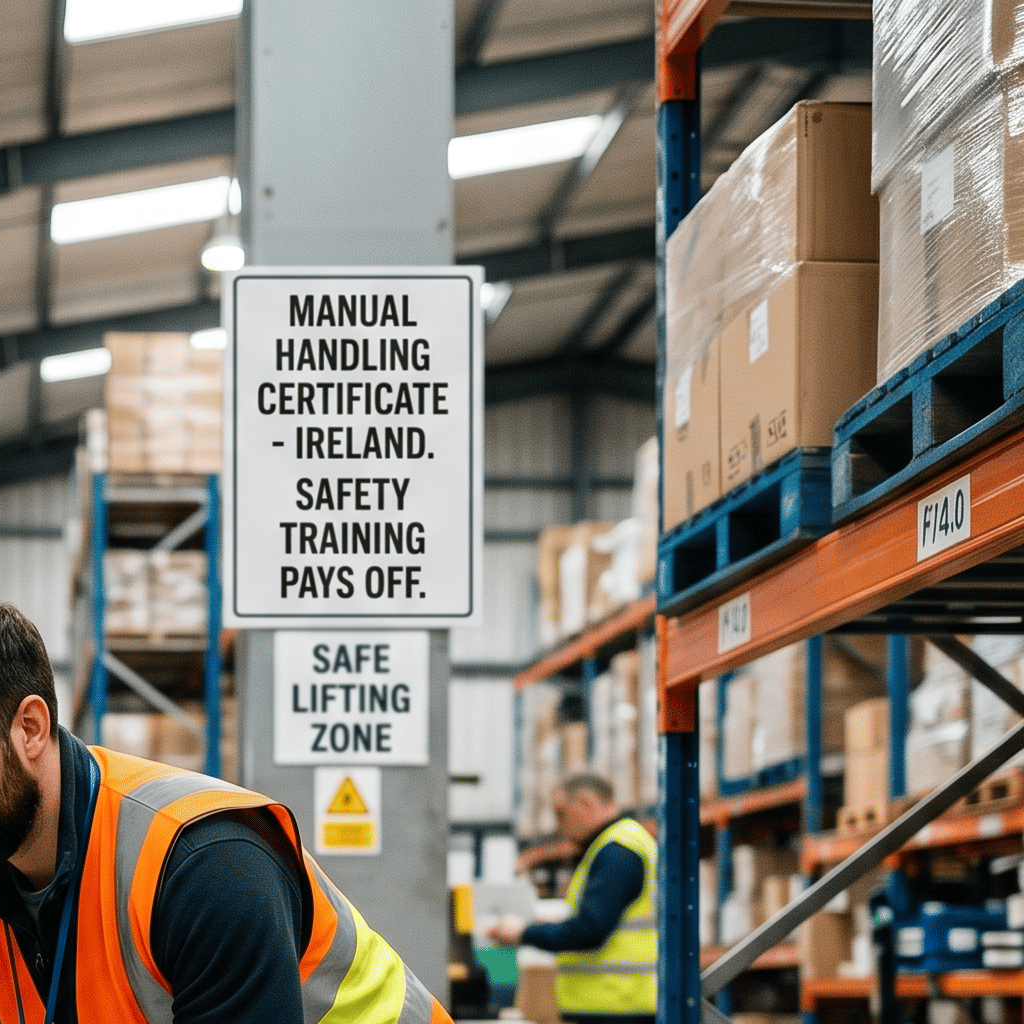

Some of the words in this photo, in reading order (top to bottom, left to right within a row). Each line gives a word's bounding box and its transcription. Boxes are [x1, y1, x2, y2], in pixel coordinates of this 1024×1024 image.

[289, 294, 418, 327] MANUAL
[276, 338, 430, 372] HANDLING
[257, 382, 449, 415] CERTIFICATE
[296, 426, 434, 459] IRELAND.
[295, 477, 411, 511] SAFETY
[922, 488, 965, 548] F/4.0
[279, 521, 426, 555] TRAINING
[280, 565, 355, 599] PAYS
[365, 565, 426, 599] OFF.
[312, 643, 391, 675] SAFE
[291, 683, 411, 714] LIFTING
[310, 722, 393, 753] ZONE
